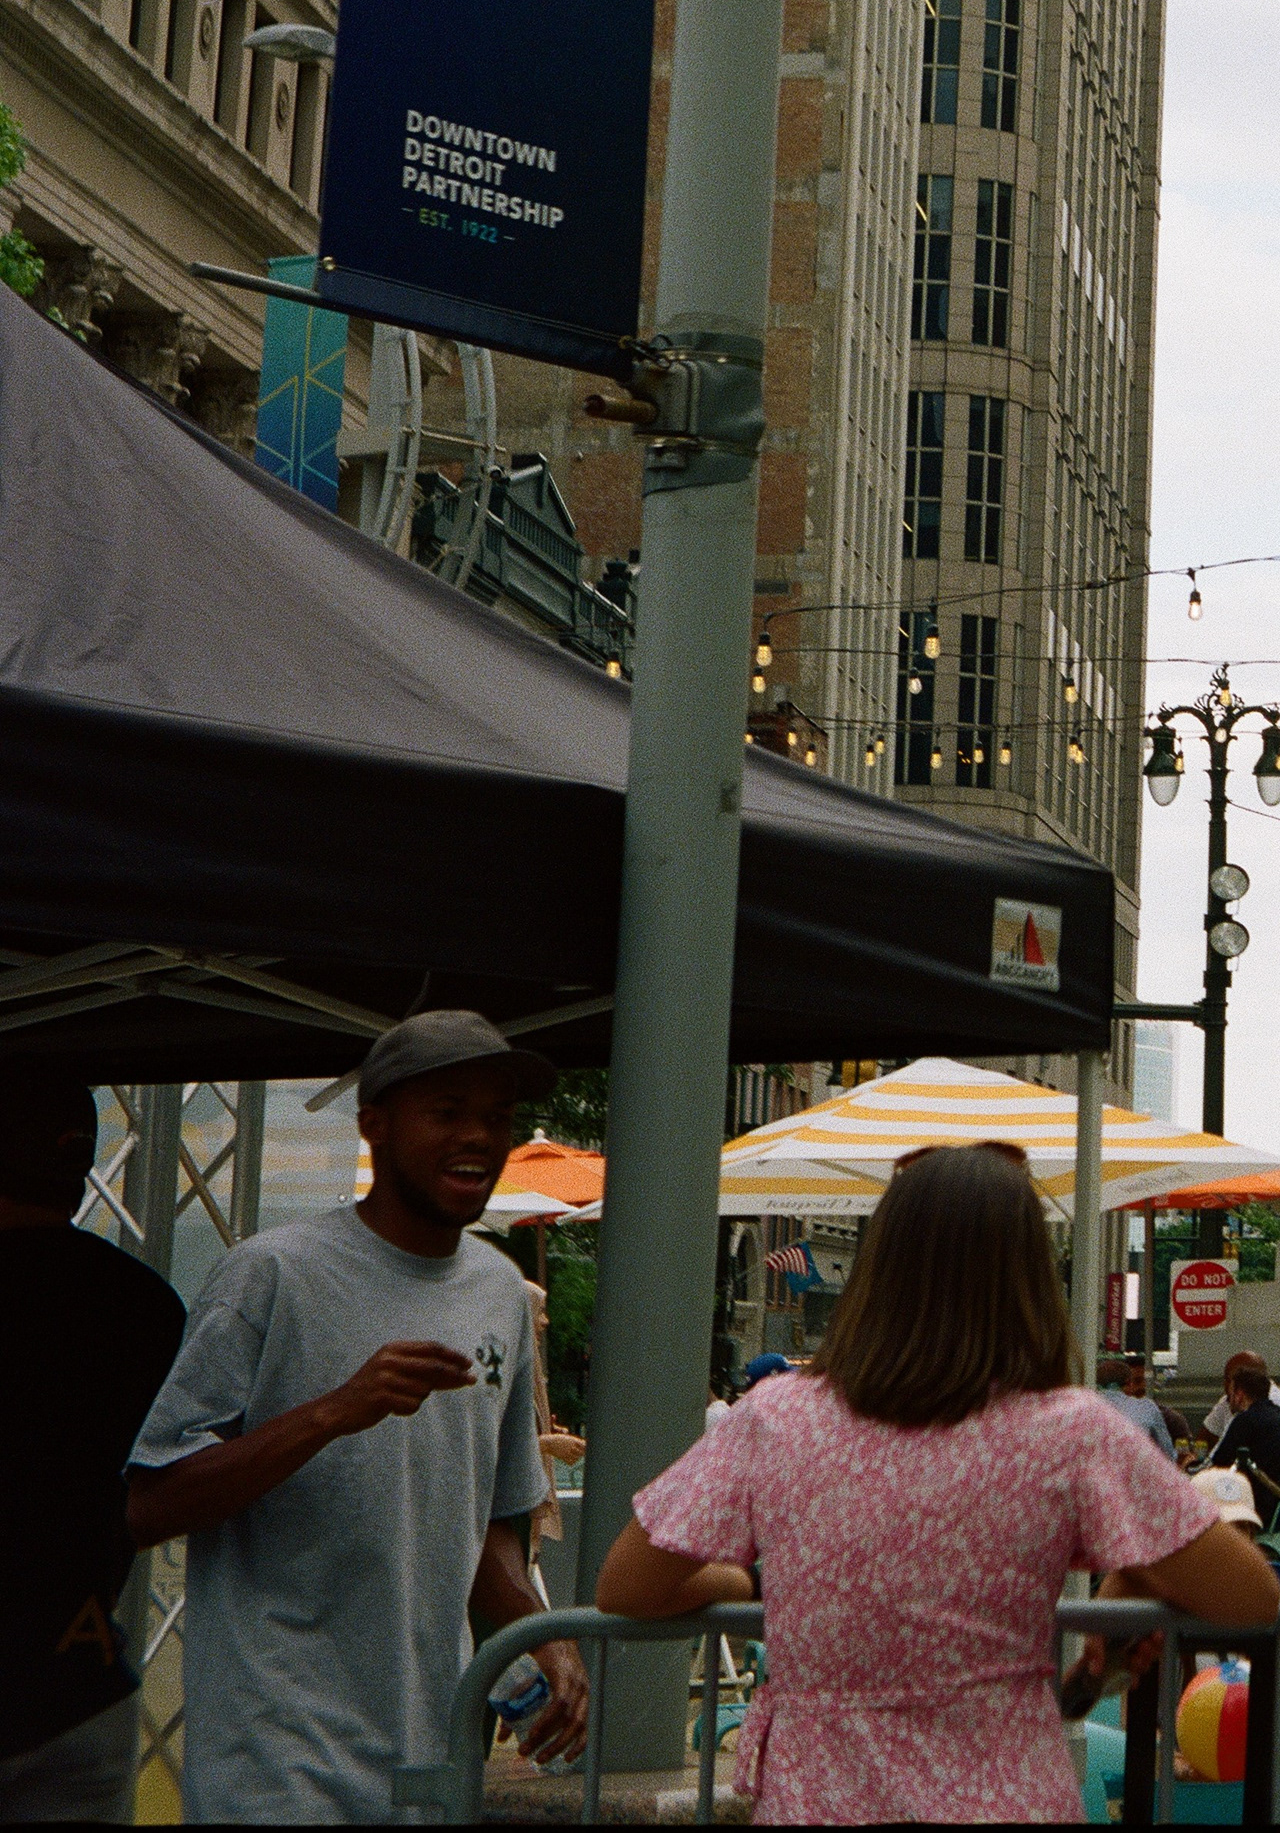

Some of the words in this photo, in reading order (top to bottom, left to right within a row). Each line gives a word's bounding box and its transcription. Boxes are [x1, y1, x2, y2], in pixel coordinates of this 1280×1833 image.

[404, 137, 507, 187] DETROIT
[406, 109, 557, 173] DOWNTOWN
[402, 166, 565, 229] PARTNERSHIP
[418, 207, 454, 232] EST.
[461, 219, 498, 244] 1922
[1181, 1273, 1198, 1286] DO
[1203, 1271, 1227, 1285] NOT
[1184, 1304, 1222, 1317] ENTER
